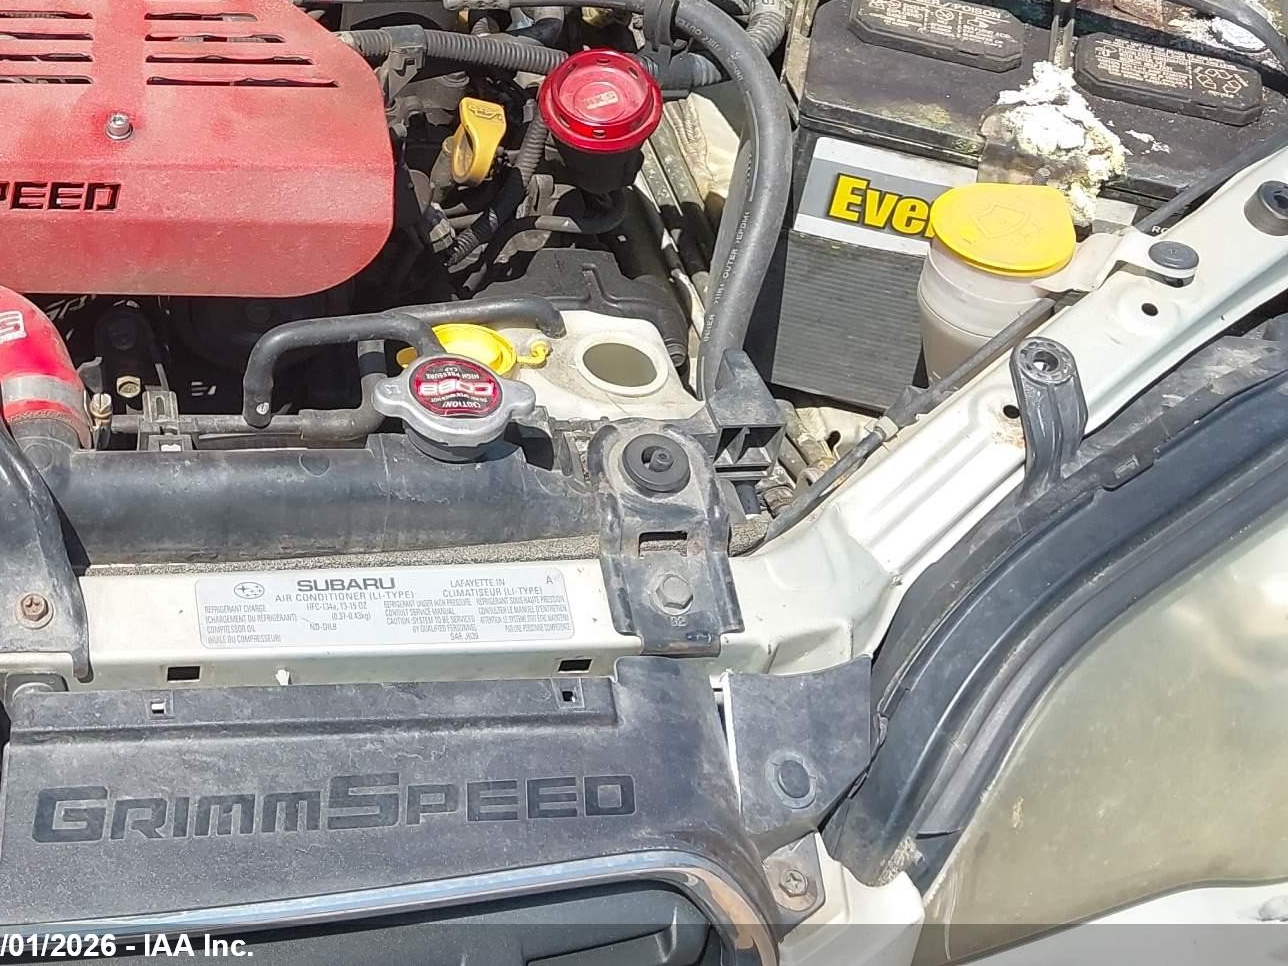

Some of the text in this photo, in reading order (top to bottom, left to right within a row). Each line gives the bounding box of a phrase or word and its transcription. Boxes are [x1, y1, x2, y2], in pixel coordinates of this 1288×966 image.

[951, 3, 1001, 19] POISON
[828, 172, 937, 238] Eve
[722, 248, 739, 280] OUTER
[296, 577, 396, 592] SUBARU
[450, 579, 493, 588] LAFAYETTE
[546, 576, 553, 584] A
[295, 593, 366, 602] CONDITIONER
[443, 587, 543, 598] CLIMATISEUR (LI-TYPE)
